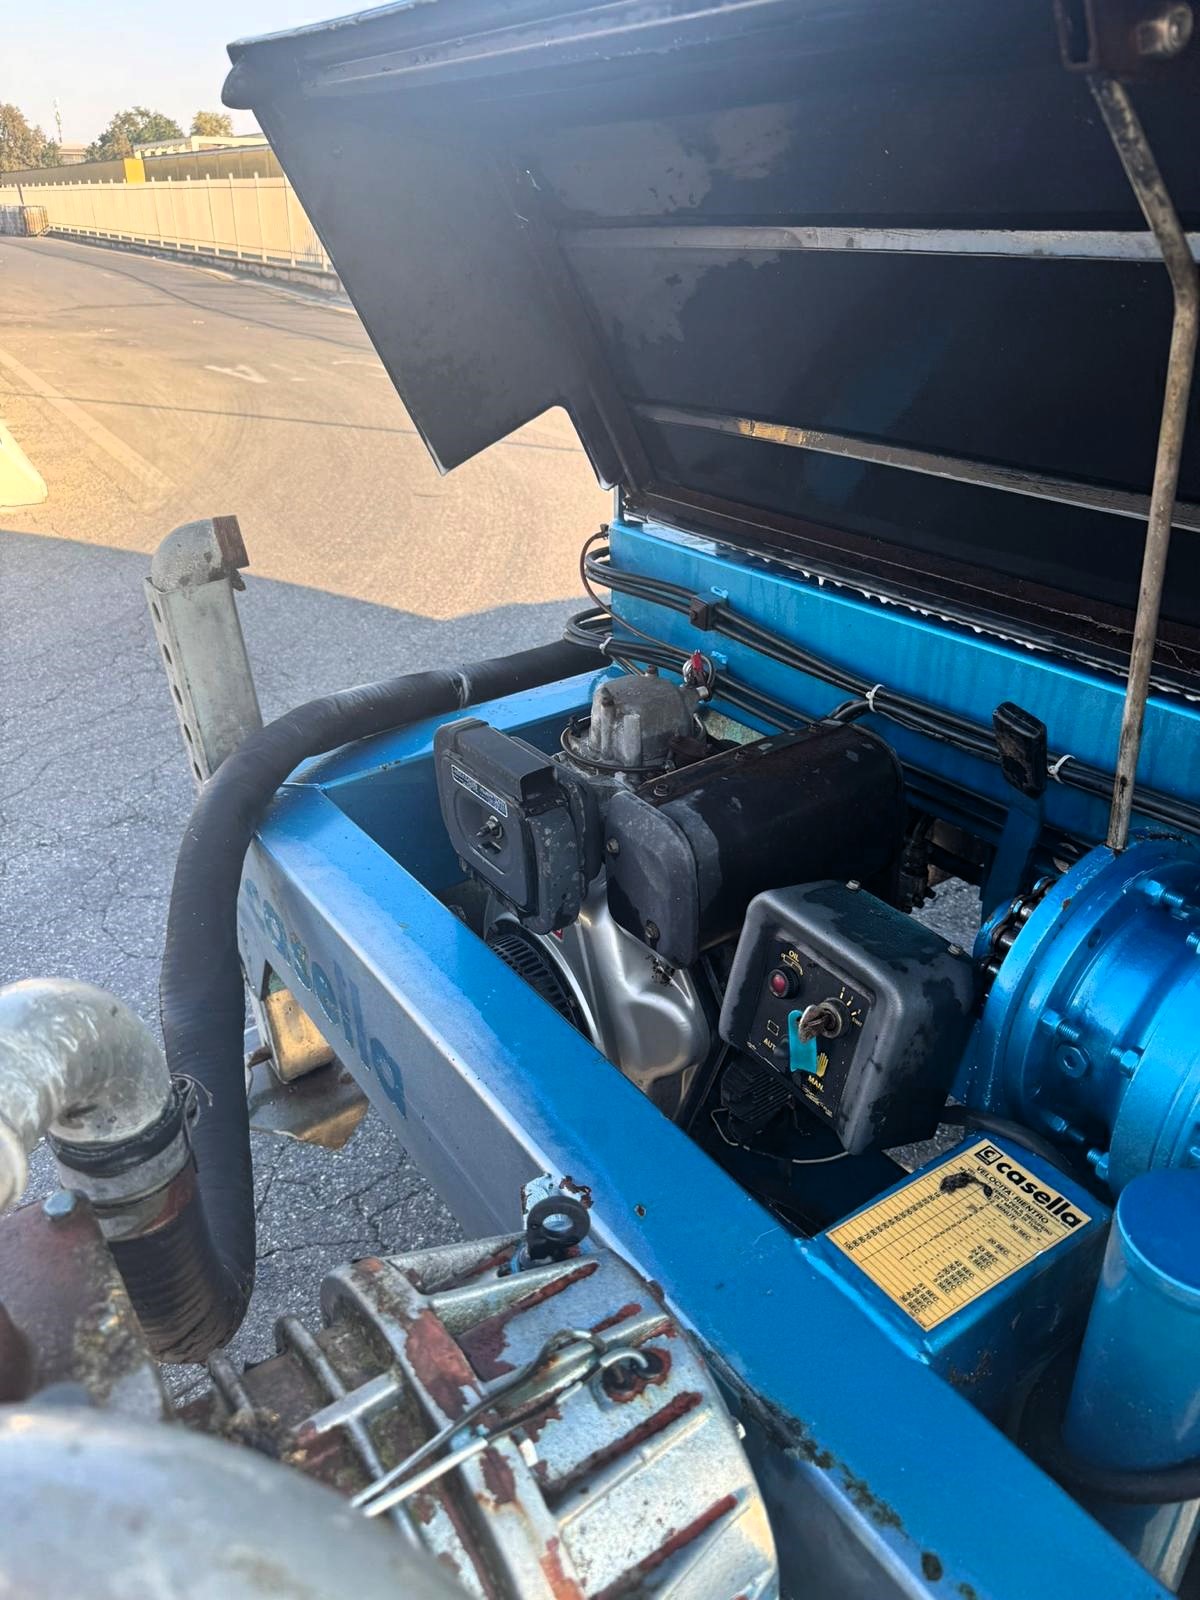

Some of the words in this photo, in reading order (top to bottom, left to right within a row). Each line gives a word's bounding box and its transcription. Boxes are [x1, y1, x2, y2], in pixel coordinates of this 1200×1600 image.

[789, 950, 800, 962] OIL
[974, 1166, 1015, 1197] VELOCITA'
[1012, 1195, 1049, 1224] RIENTRO
[996, 1162, 1083, 1228] casella
